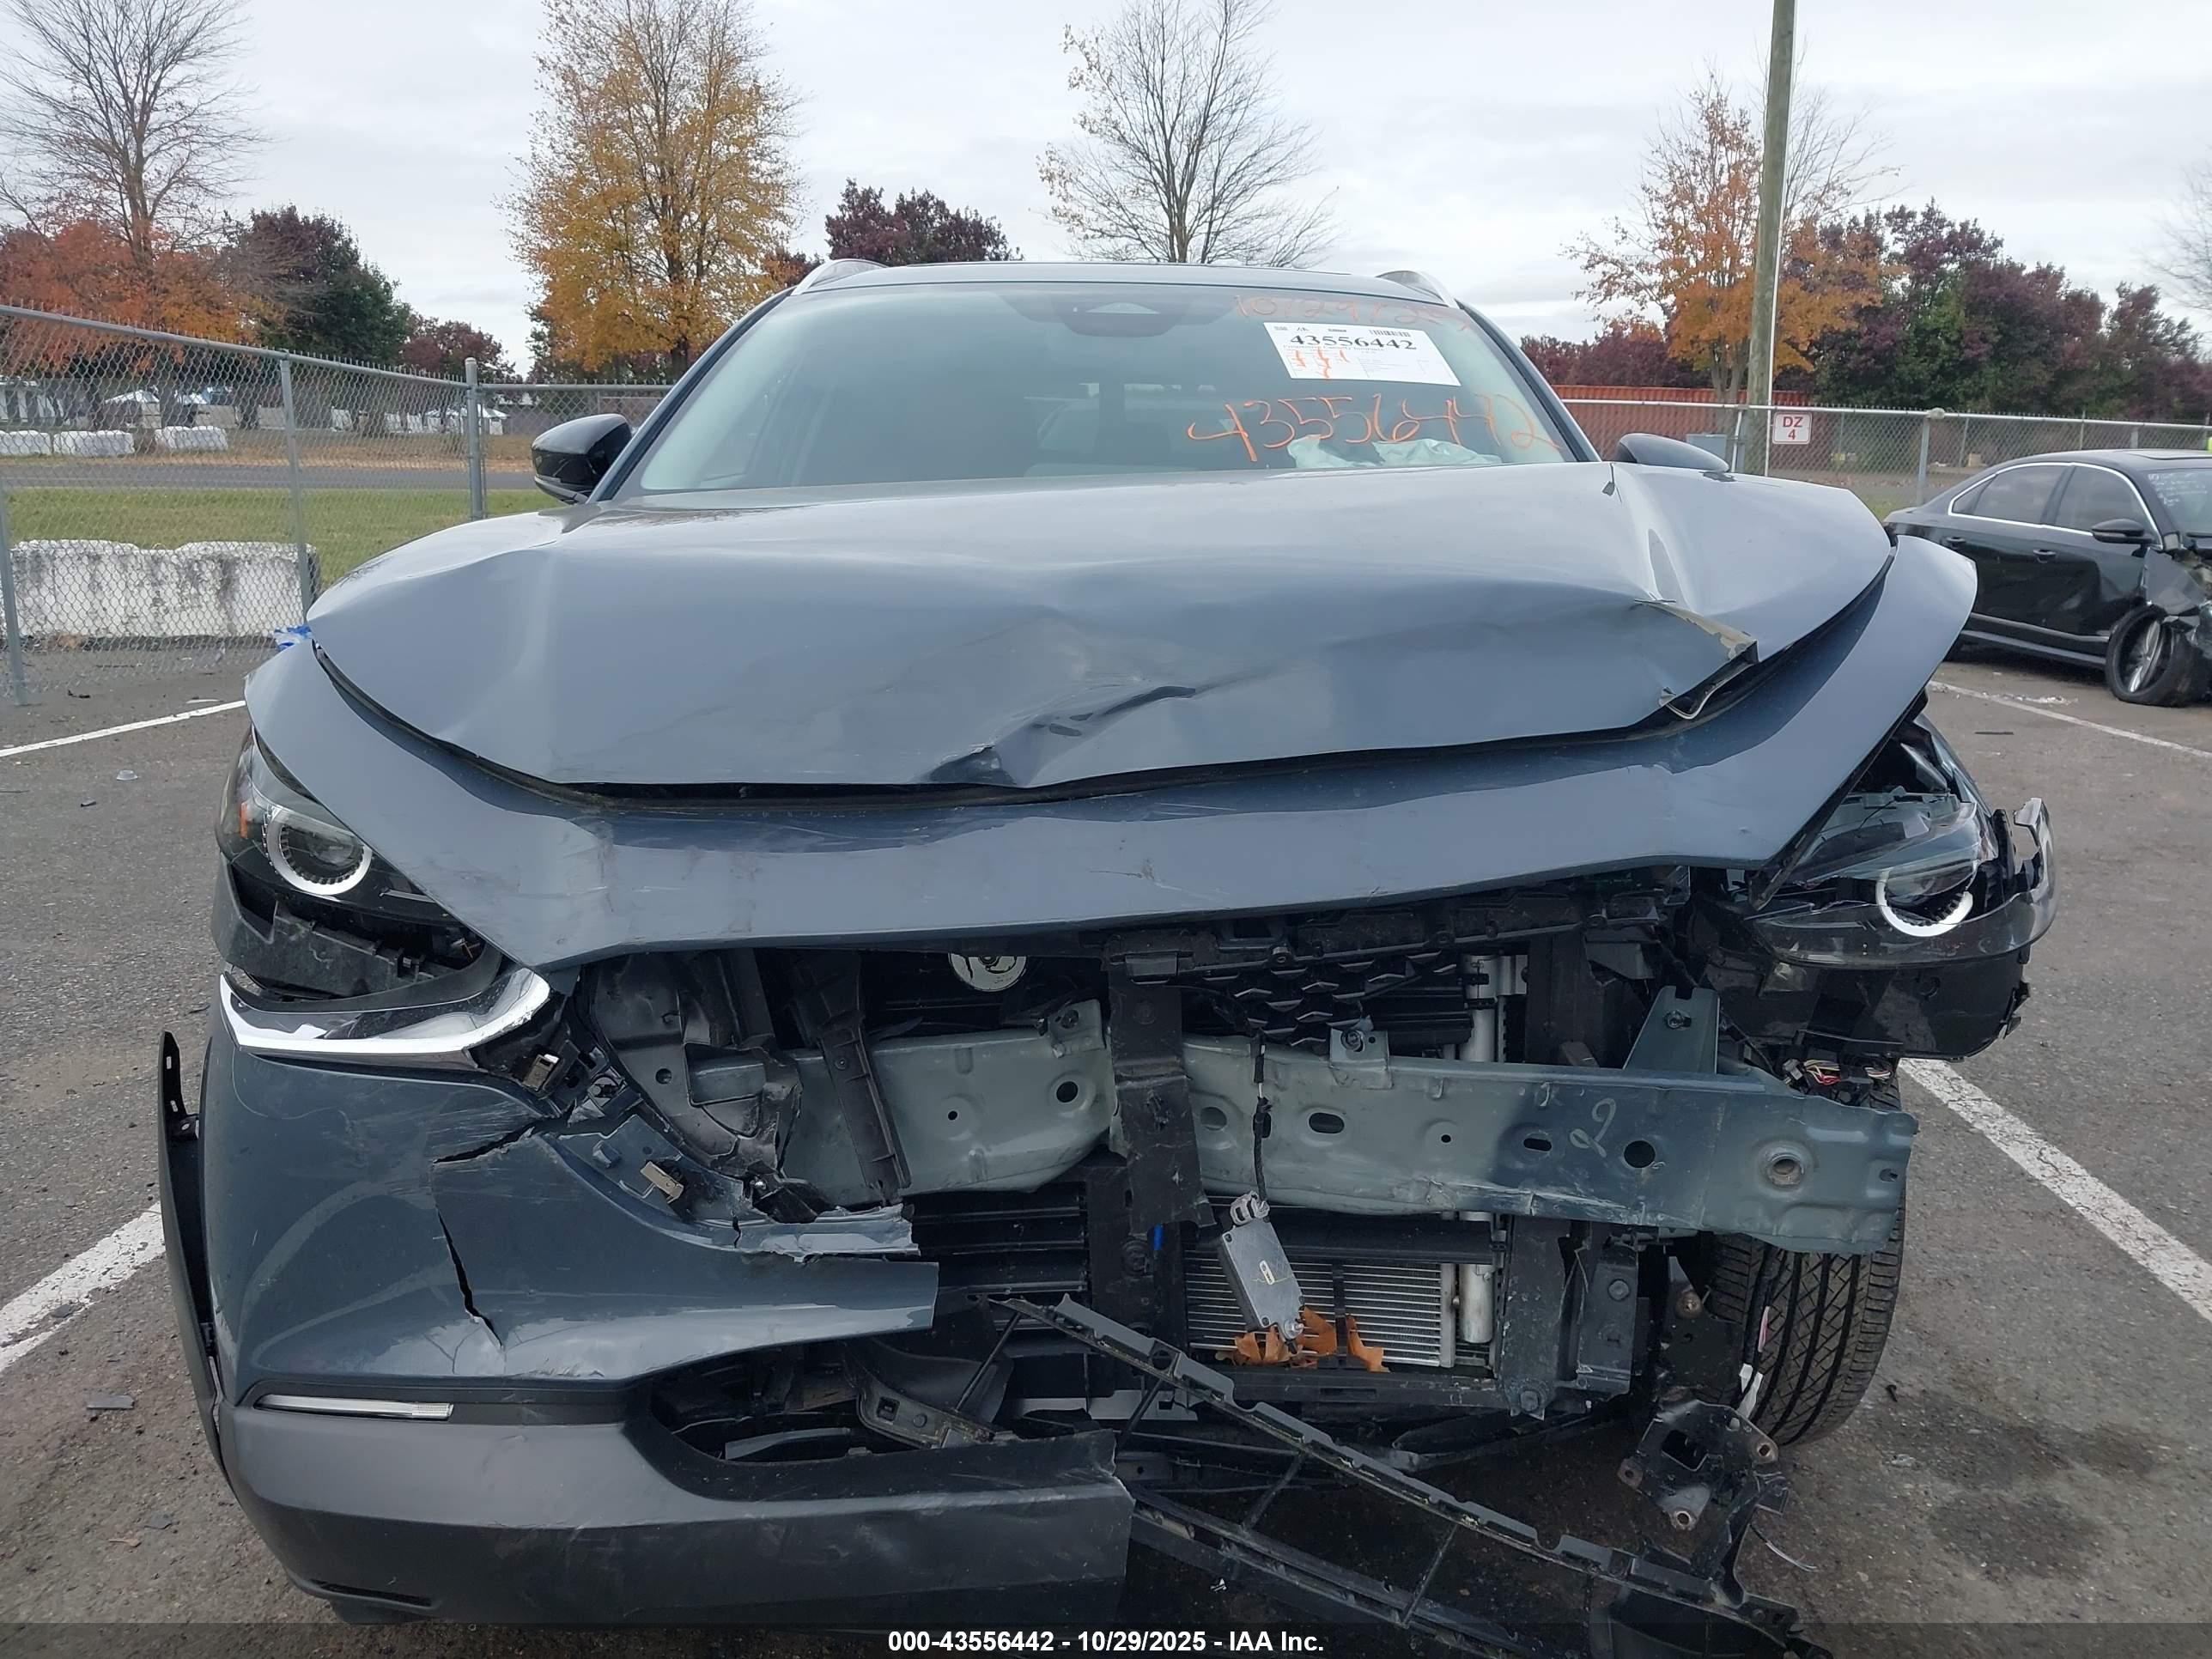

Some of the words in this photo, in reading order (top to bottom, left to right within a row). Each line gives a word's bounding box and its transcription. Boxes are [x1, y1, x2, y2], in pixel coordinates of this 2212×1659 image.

[1291, 334, 1417, 350] 43556442
[1188, 392, 1563, 462] 43556442
[1783, 416, 1803, 428] DZ
[1788, 429, 1796, 441] 4
